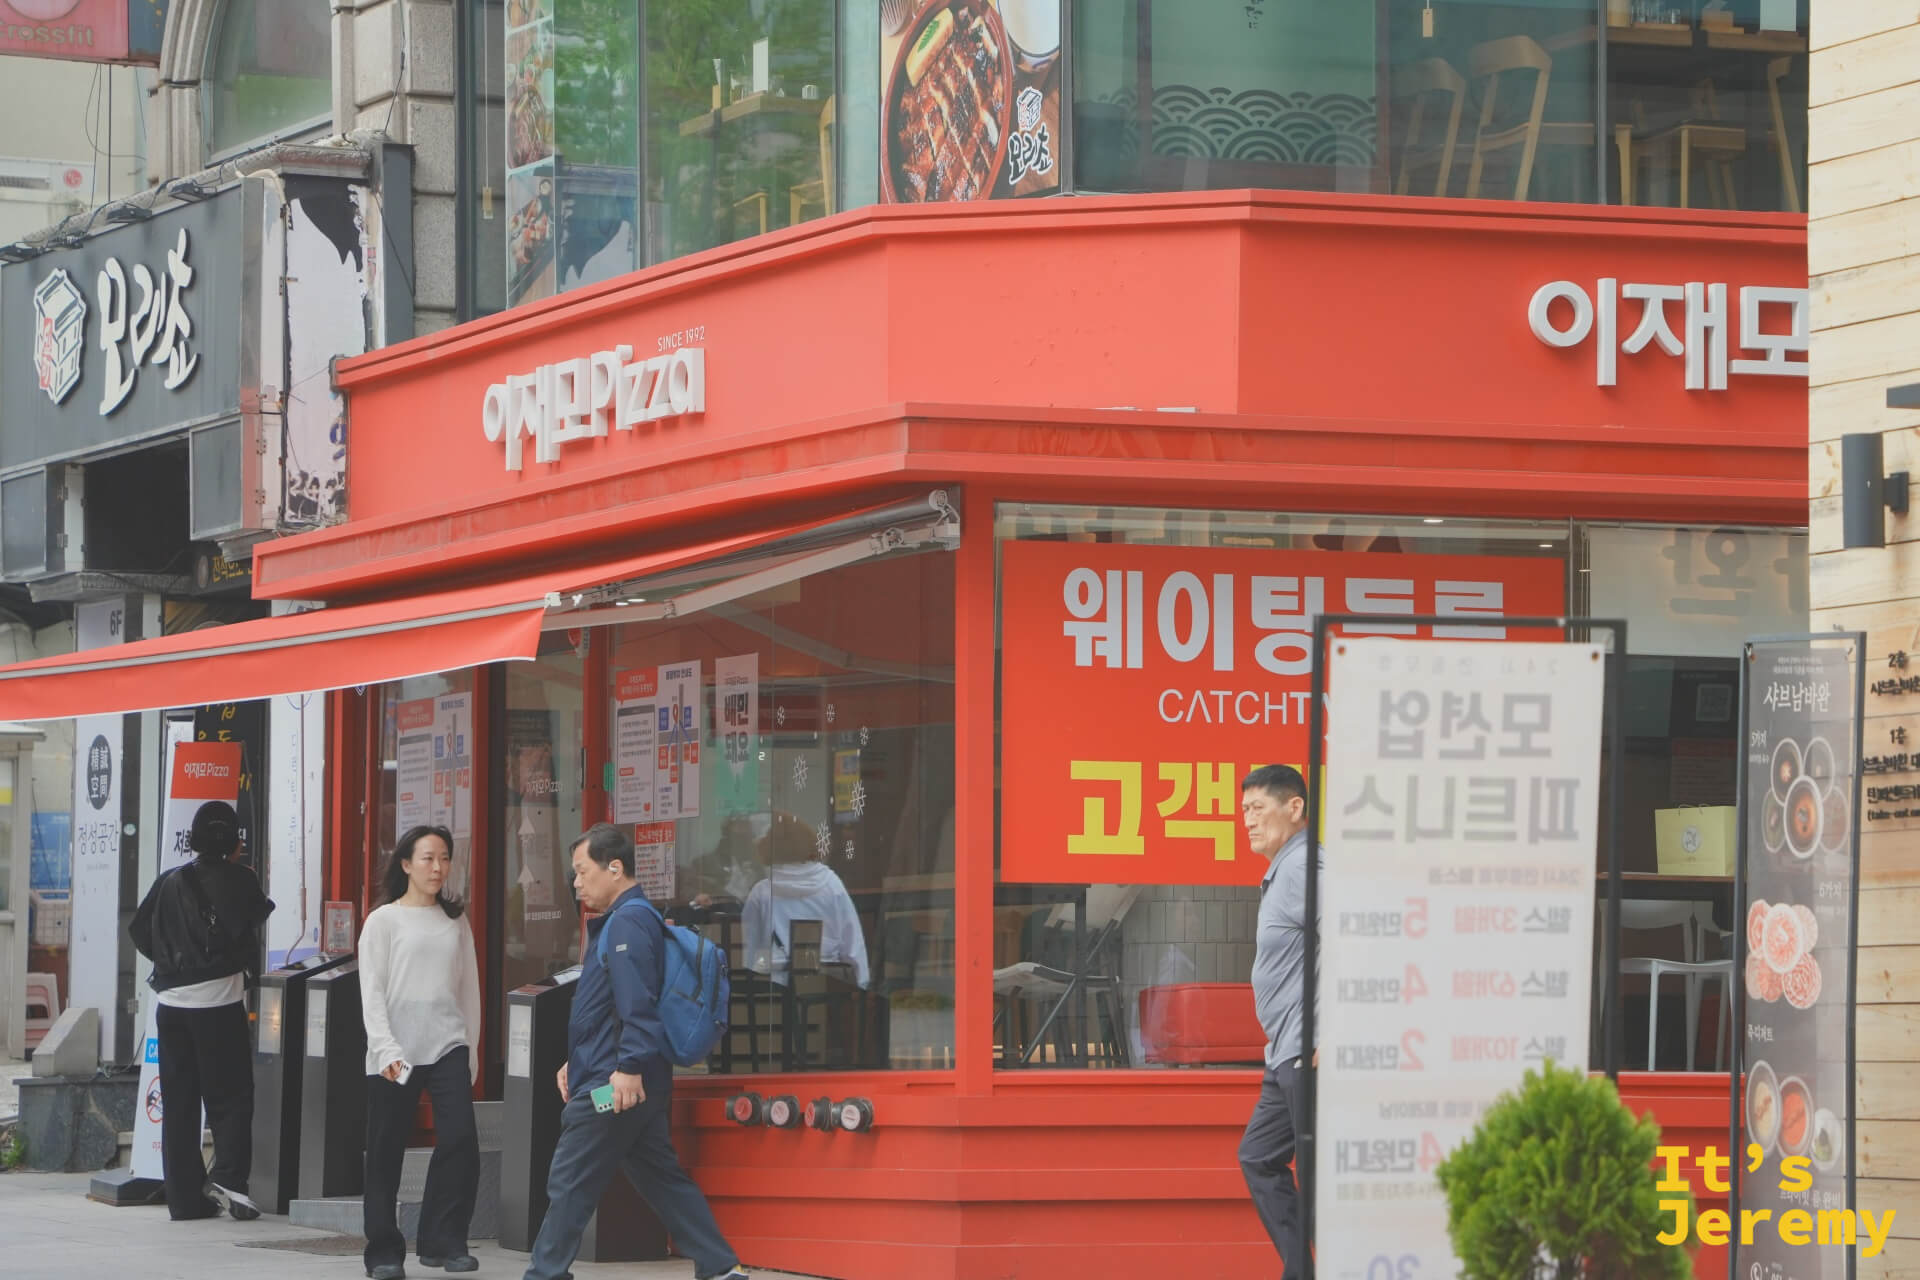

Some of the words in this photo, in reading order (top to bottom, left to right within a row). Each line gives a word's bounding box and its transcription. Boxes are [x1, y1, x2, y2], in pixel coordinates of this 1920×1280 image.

[657, 331, 683, 352] SINCE
[685, 325, 705, 345] 1992
[110, 609, 123, 637] 6F
[1158, 689, 1331, 725] CATCHT
[78, 820, 119, 856] 정성공간
